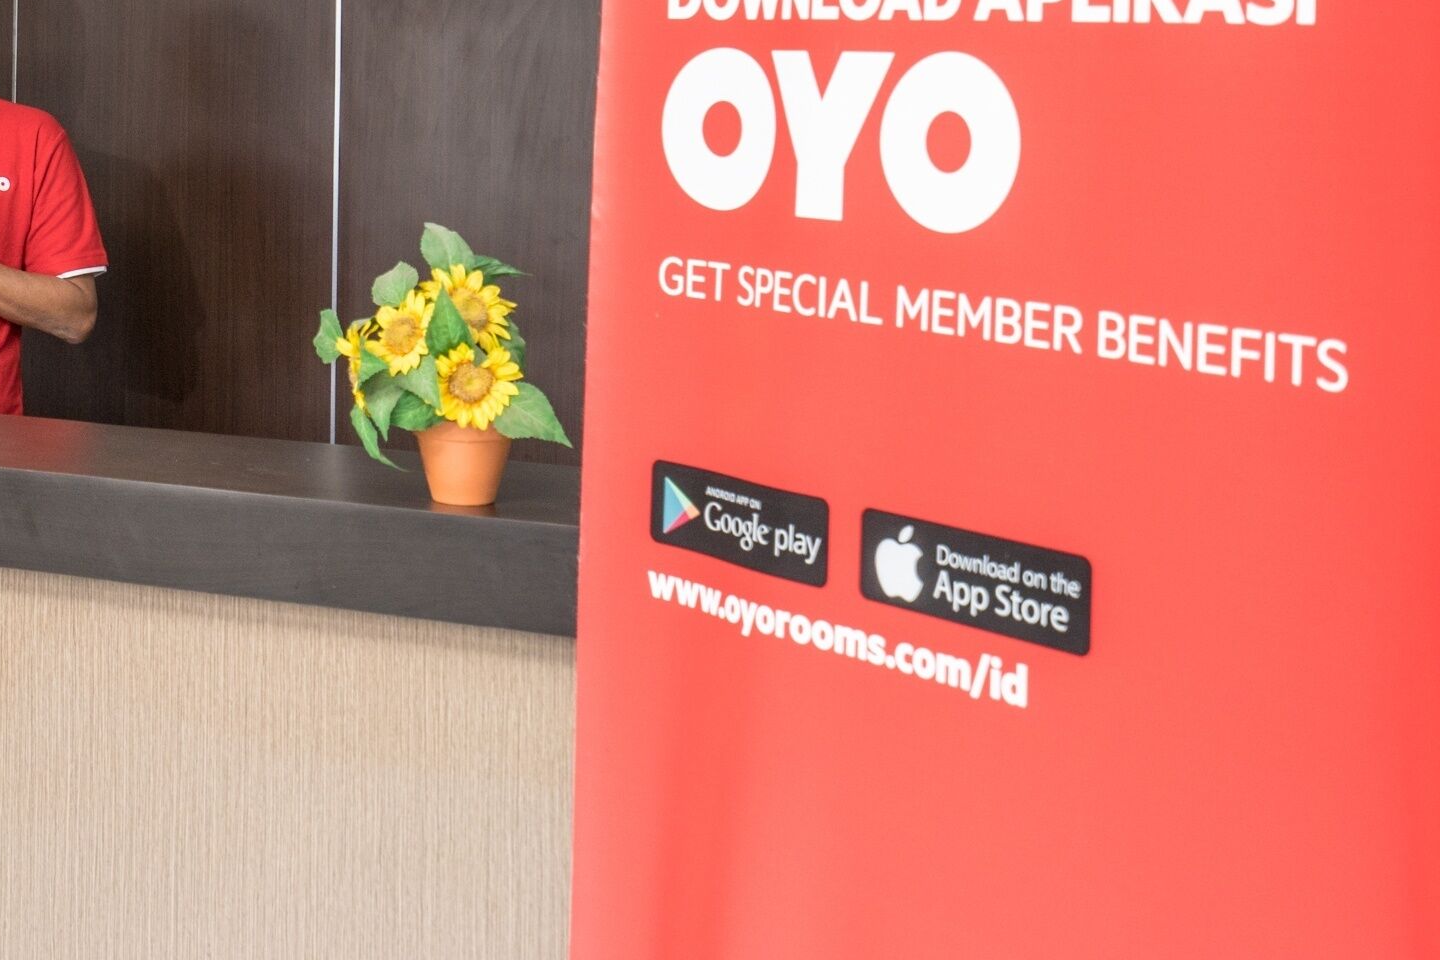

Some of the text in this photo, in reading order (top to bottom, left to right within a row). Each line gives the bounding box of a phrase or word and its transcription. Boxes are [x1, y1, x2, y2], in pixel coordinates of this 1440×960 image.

[661, 47, 1022, 234] OYO
[658, 256, 1350, 394] GET SPECIAL MEMBER BENEFITS
[705, 486, 762, 511] ANDROID APP ON
[704, 501, 822, 565] Google play
[932, 570, 1070, 633] App Store
[935, 544, 1082, 599] Download on the
[647, 570, 1029, 709] www.oyorooms.com/id
